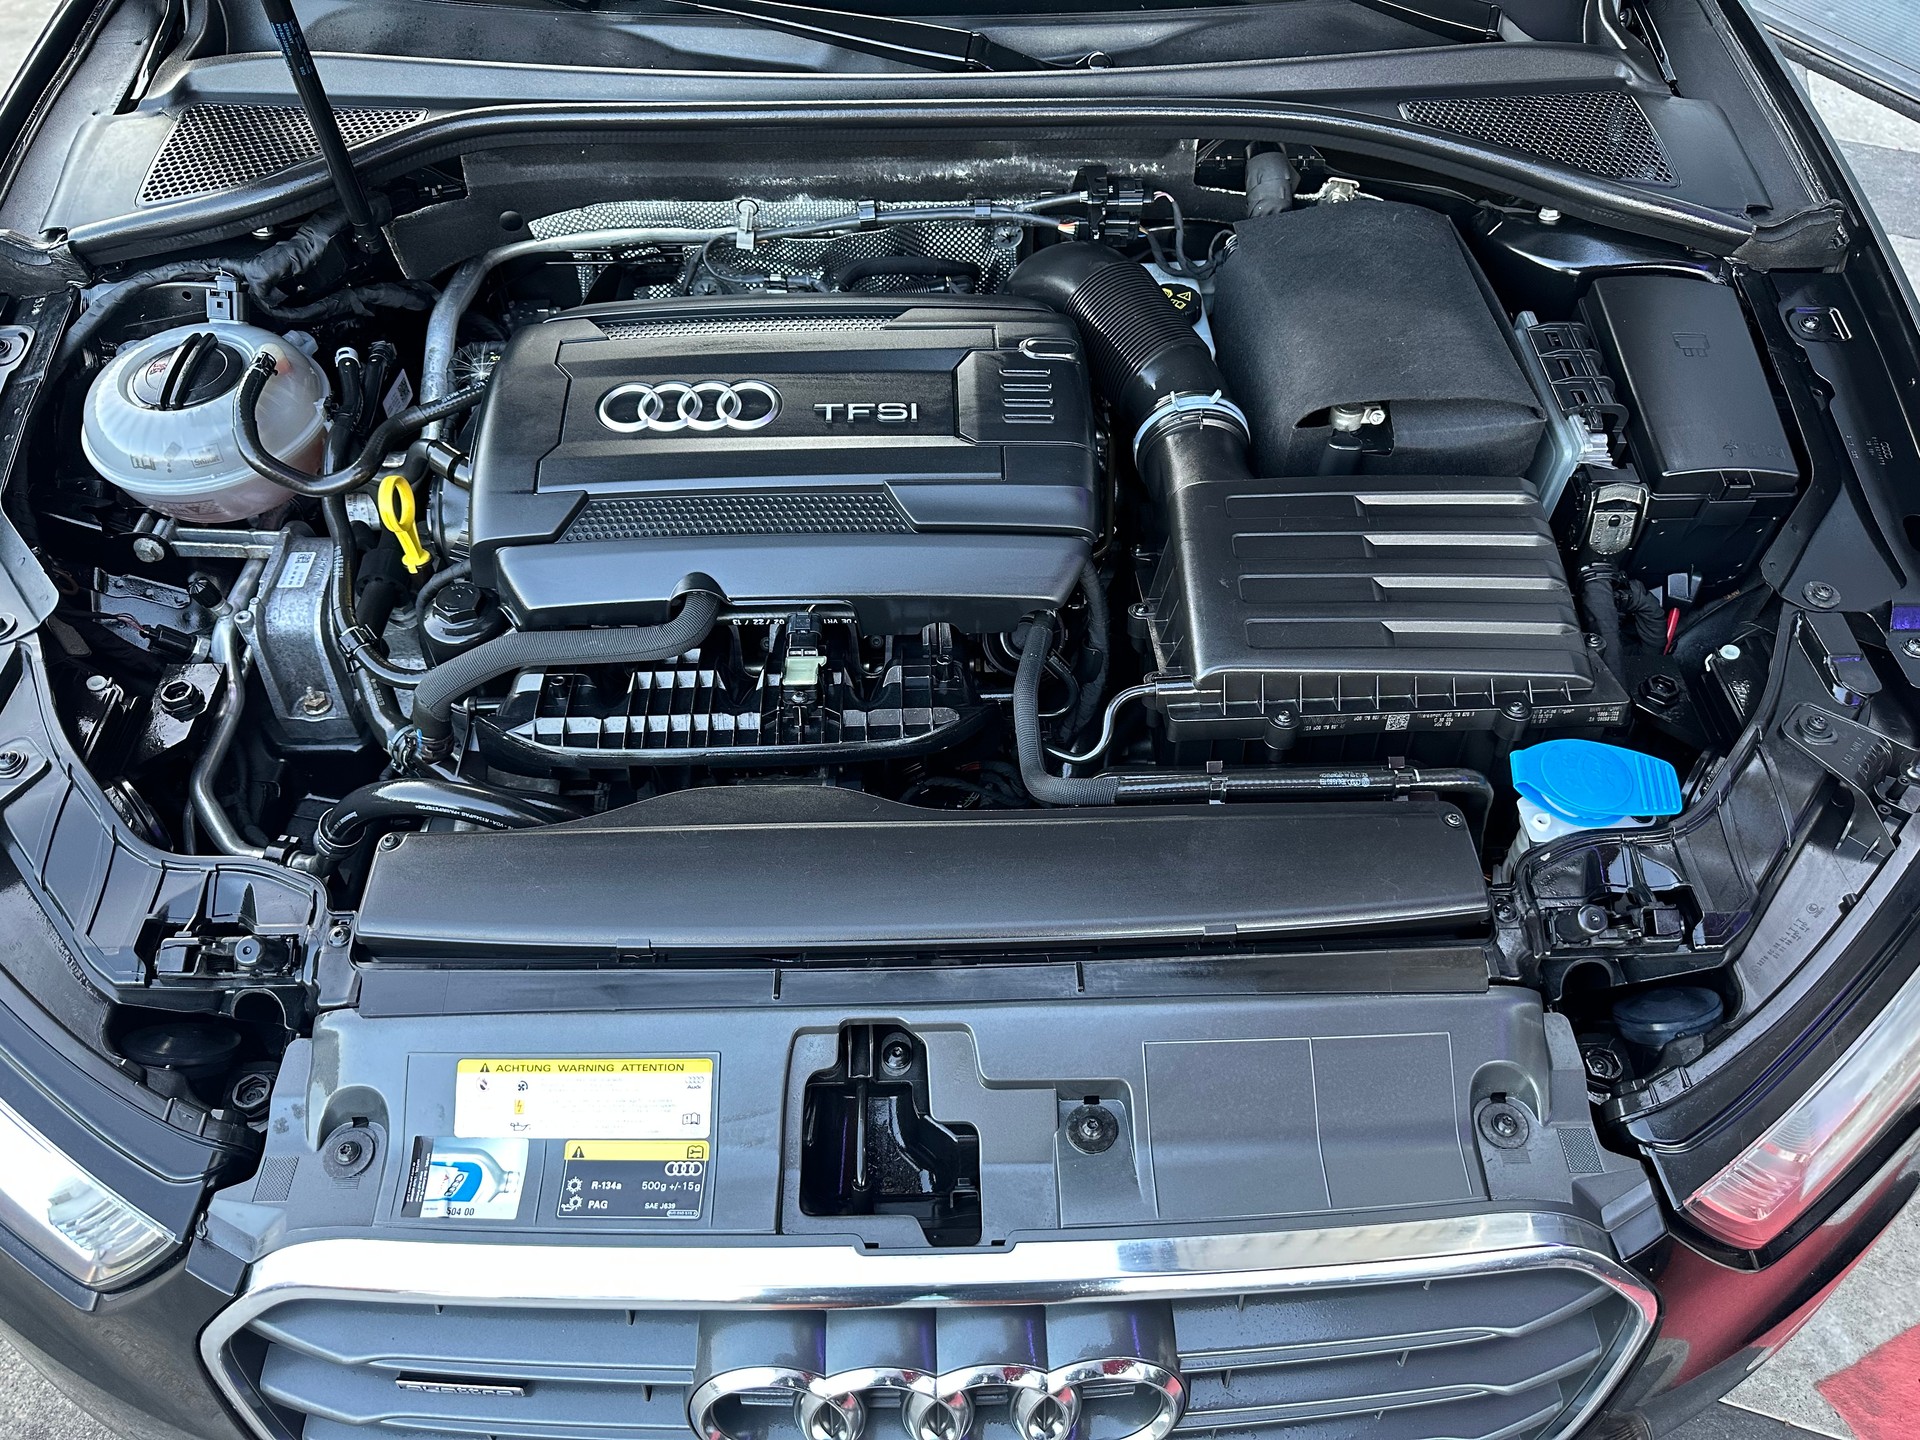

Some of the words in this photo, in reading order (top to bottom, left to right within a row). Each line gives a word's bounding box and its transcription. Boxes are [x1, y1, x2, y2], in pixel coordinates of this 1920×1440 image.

[813, 402, 919, 424] TFSI
[496, 1064, 551, 1073] ACHTUNG
[558, 1064, 614, 1072] WARNING
[621, 1063, 685, 1072] ATTENTION
[591, 1182, 622, 1190] R-134a
[641, 1181, 667, 1192] 500g
[588, 1201, 609, 1209] PAG
[644, 1202, 659, 1210] SAE
[446, 1206, 461, 1216] 504
[464, 1207, 475, 1216] 00
